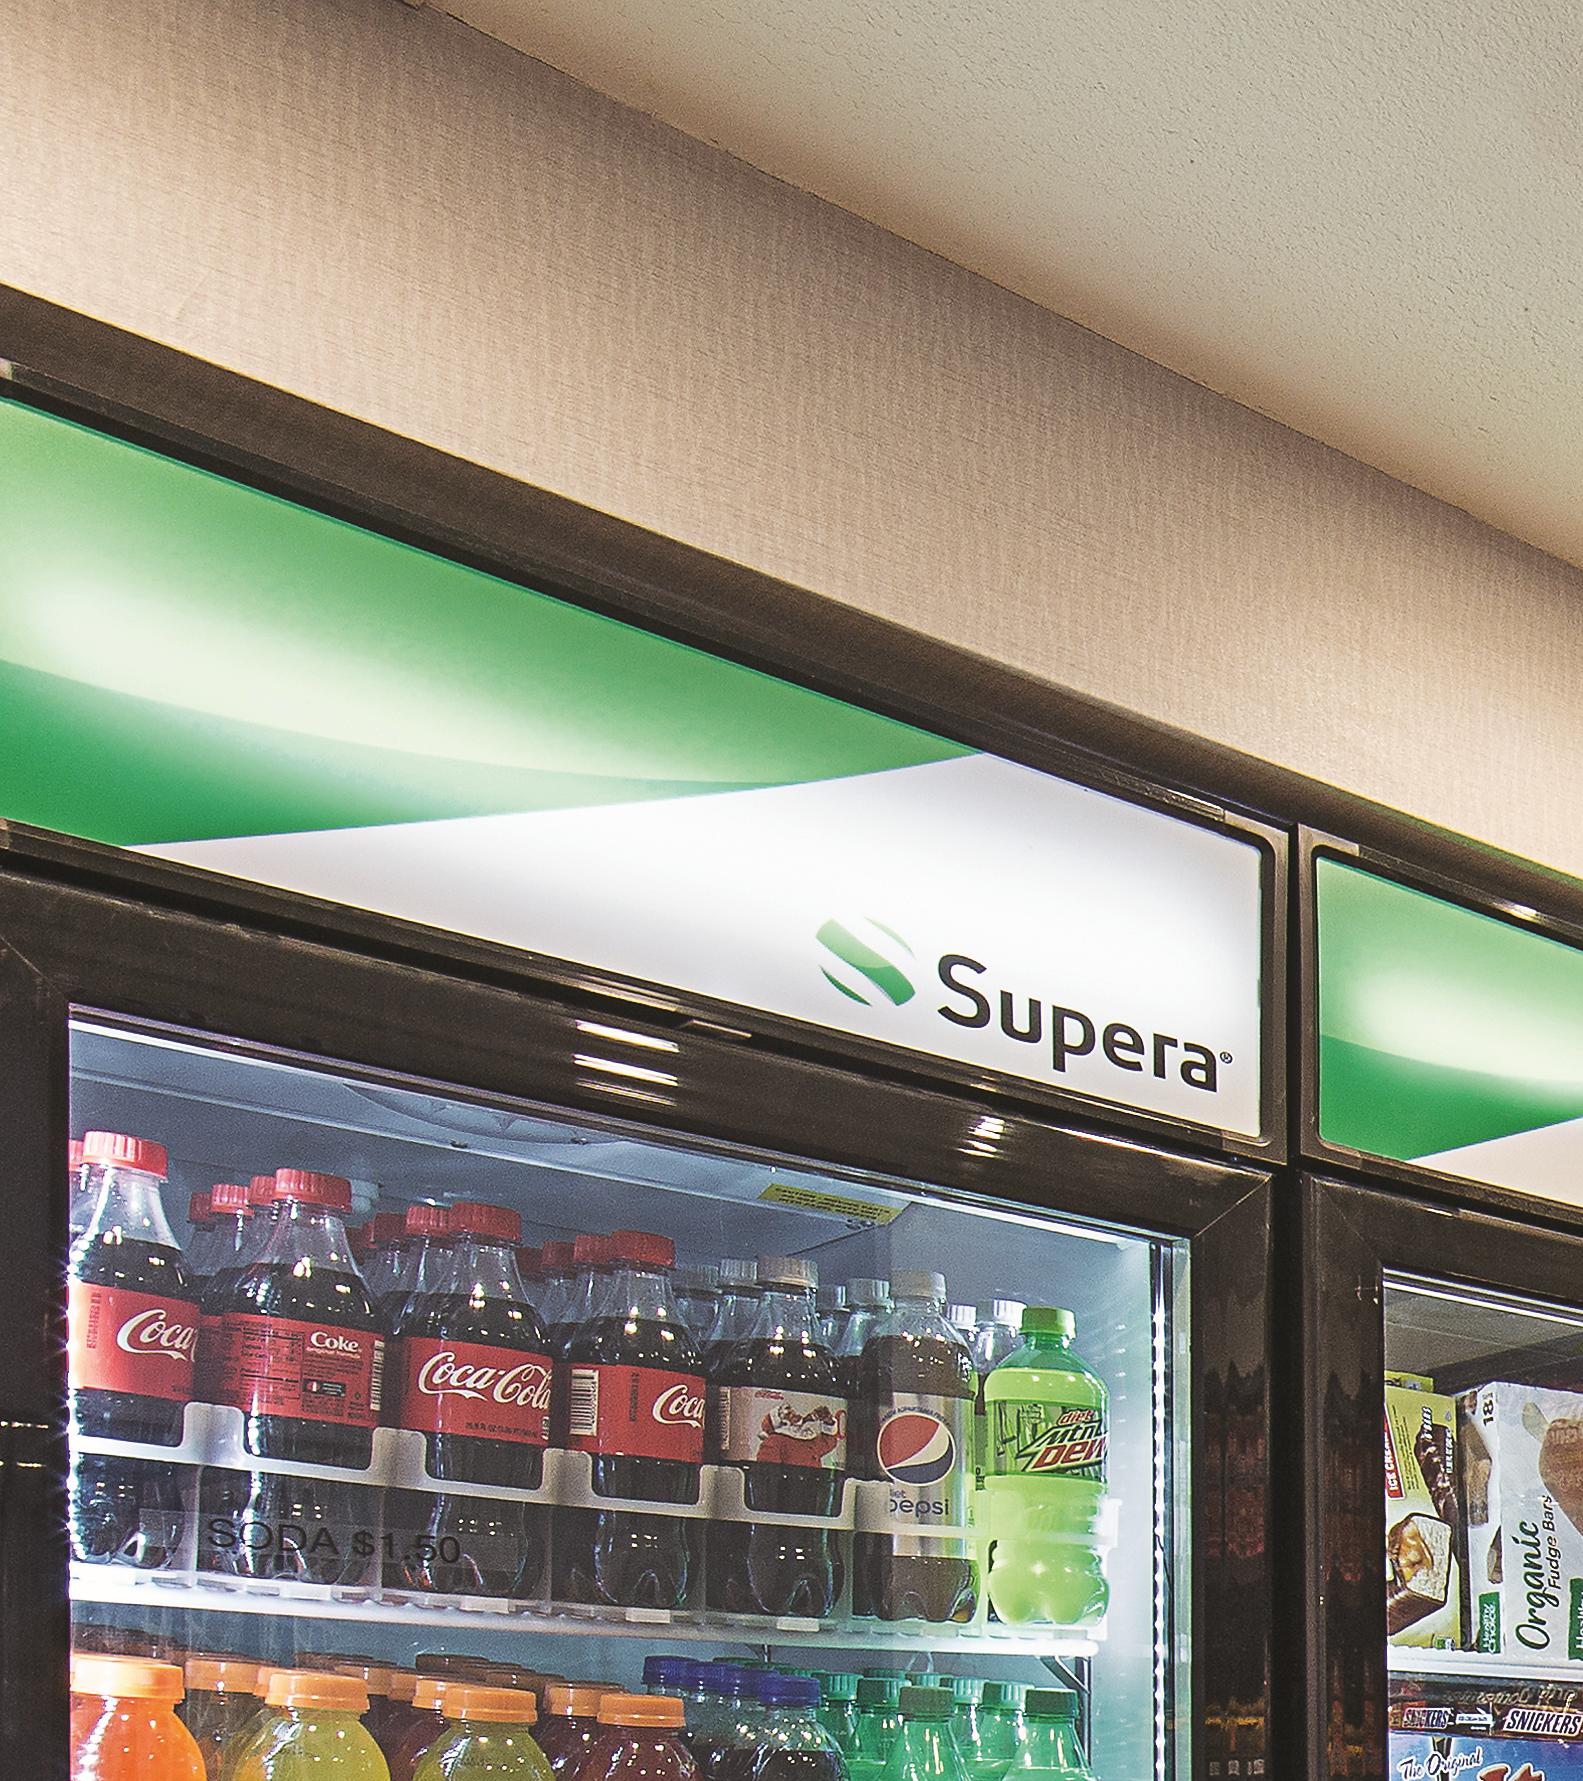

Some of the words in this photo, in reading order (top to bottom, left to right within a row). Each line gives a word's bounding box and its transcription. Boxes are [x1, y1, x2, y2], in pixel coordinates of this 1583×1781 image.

[937, 954, 1218, 1093] Supera
[310, 1331, 359, 1352] Coke
[207, 1518, 338, 1554] SODA
[353, 1530, 460, 1564] $1.50
[1516, 1521, 1559, 1649] Organic
[1507, 1709, 1582, 1735] SNICKERS
